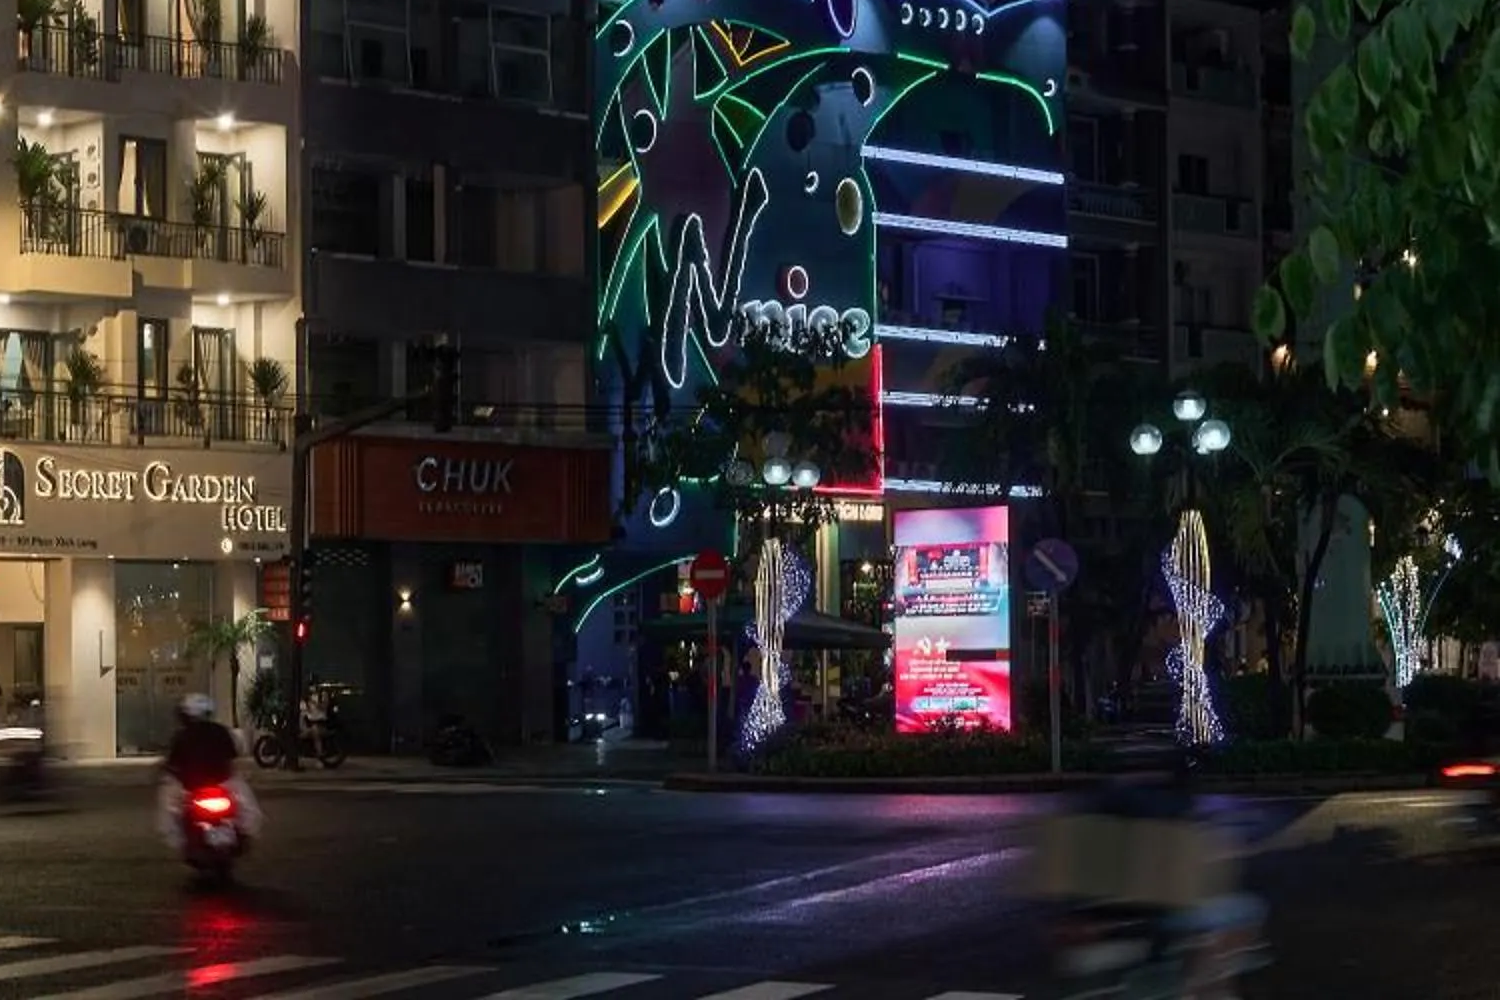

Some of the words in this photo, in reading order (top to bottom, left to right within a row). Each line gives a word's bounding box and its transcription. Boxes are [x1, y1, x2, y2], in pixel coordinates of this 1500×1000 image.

[36, 456, 138, 500] SECRET
[144, 461, 256, 503] GARDEN
[416, 456, 514, 494] CHUK
[222, 505, 287, 532] HOTEL
